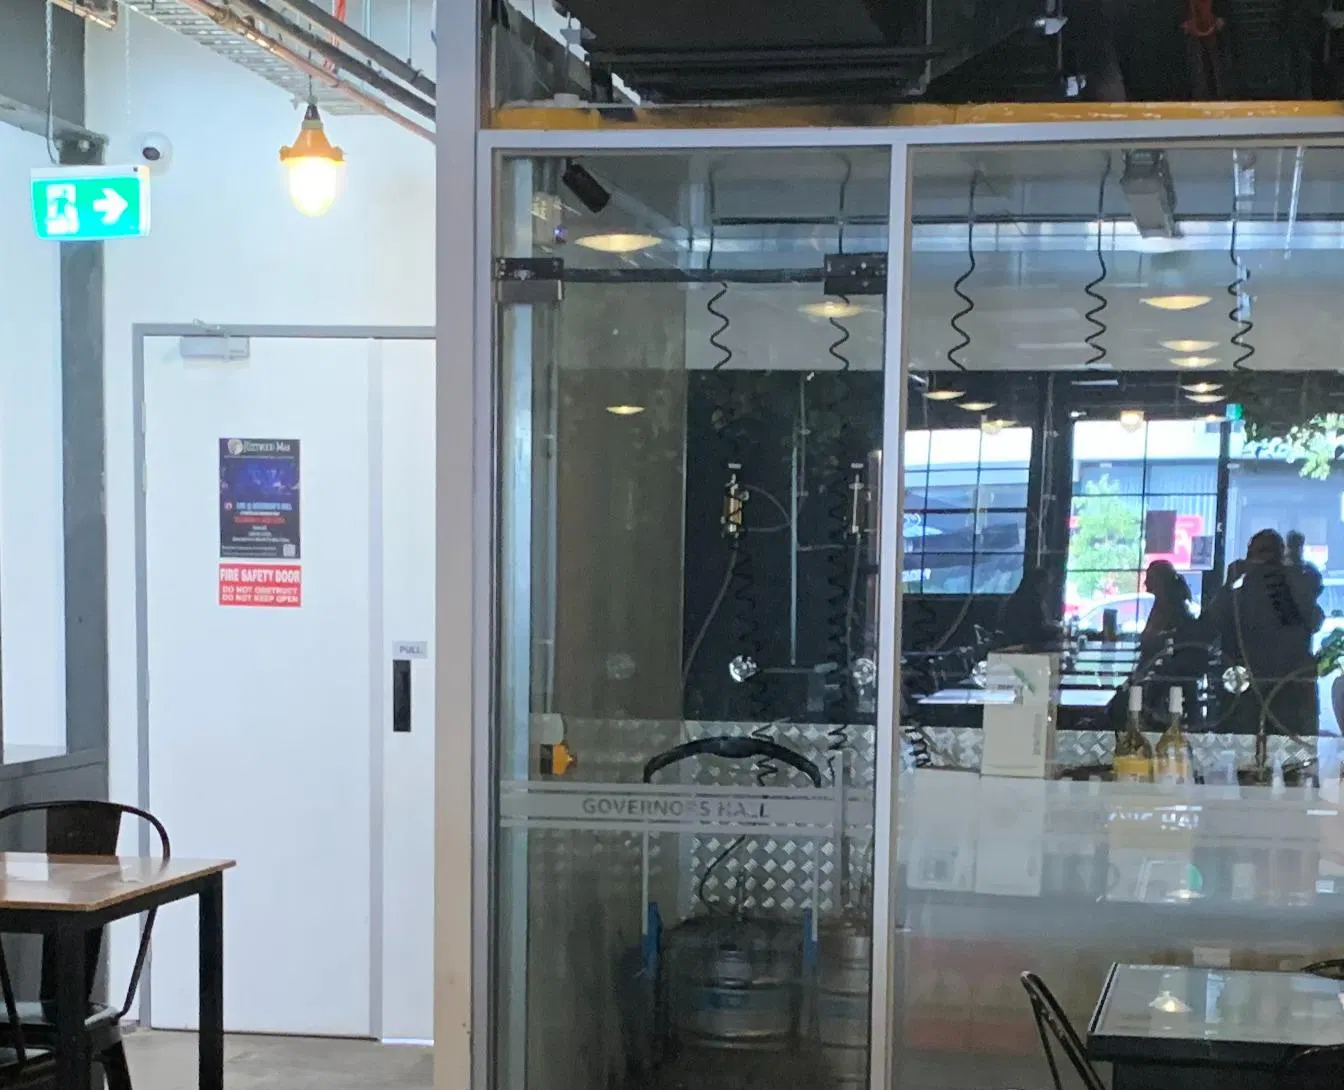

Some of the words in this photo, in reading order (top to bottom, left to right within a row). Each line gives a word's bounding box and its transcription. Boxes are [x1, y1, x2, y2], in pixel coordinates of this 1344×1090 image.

[220, 568, 239, 582] FIRE
[241, 569, 273, 583] SAFETY
[275, 570, 300, 584] DOOR
[236, 586, 253, 594] NOT
[236, 595, 252, 603] NOT
[254, 595, 275, 603] KEEP
[277, 595, 299, 604] OPEN
